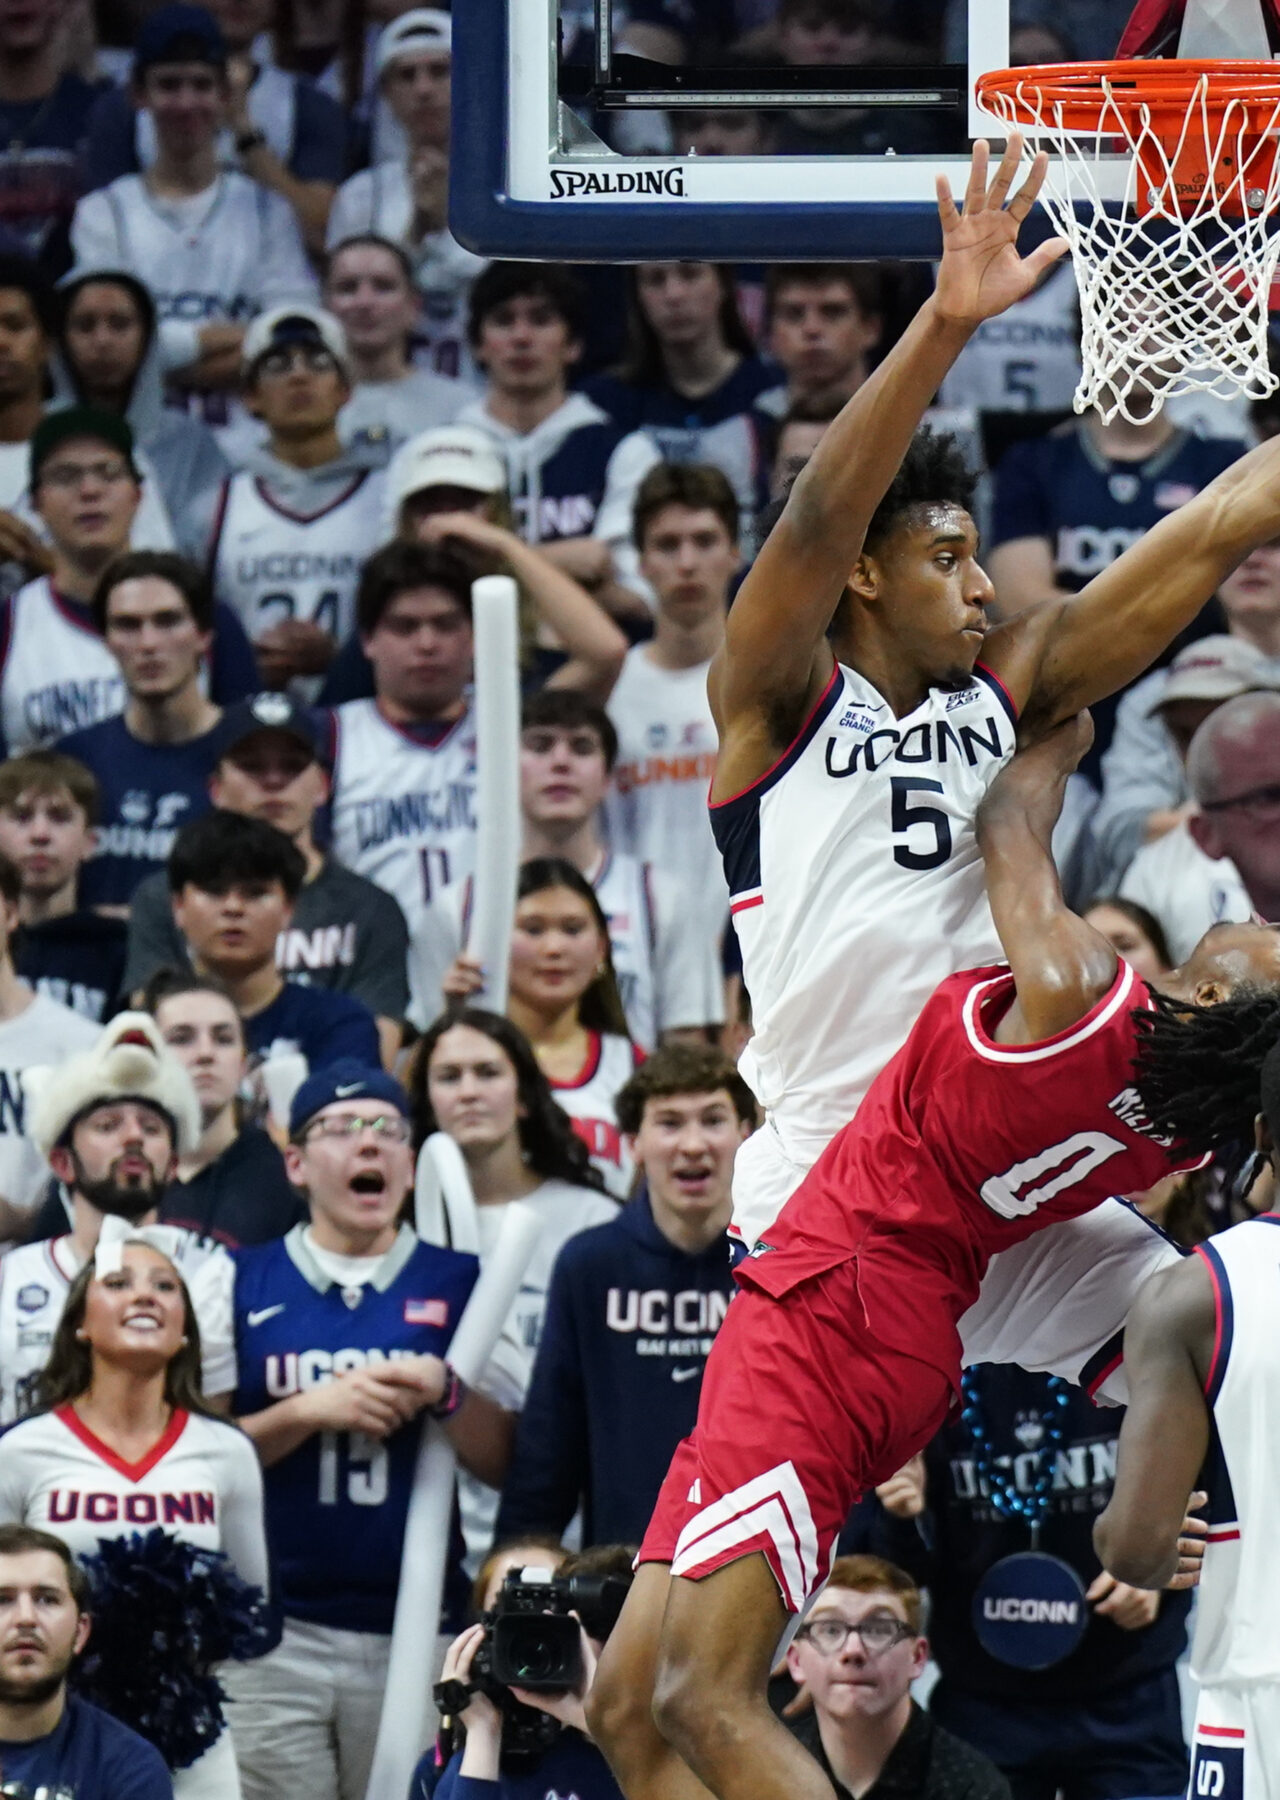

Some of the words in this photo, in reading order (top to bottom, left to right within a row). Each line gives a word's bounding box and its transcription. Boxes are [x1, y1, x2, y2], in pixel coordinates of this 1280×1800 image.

[550, 167, 688, 199] SPALDING
[845, 710, 858, 721] BE
[860, 714, 876, 728] THE
[825, 716, 1004, 779] UCONN
[890, 776, 953, 871] 5
[979, 1130, 1129, 1221] 0
[48, 1489, 216, 1525] UCONN
[983, 1597, 1078, 1625] UCONN
